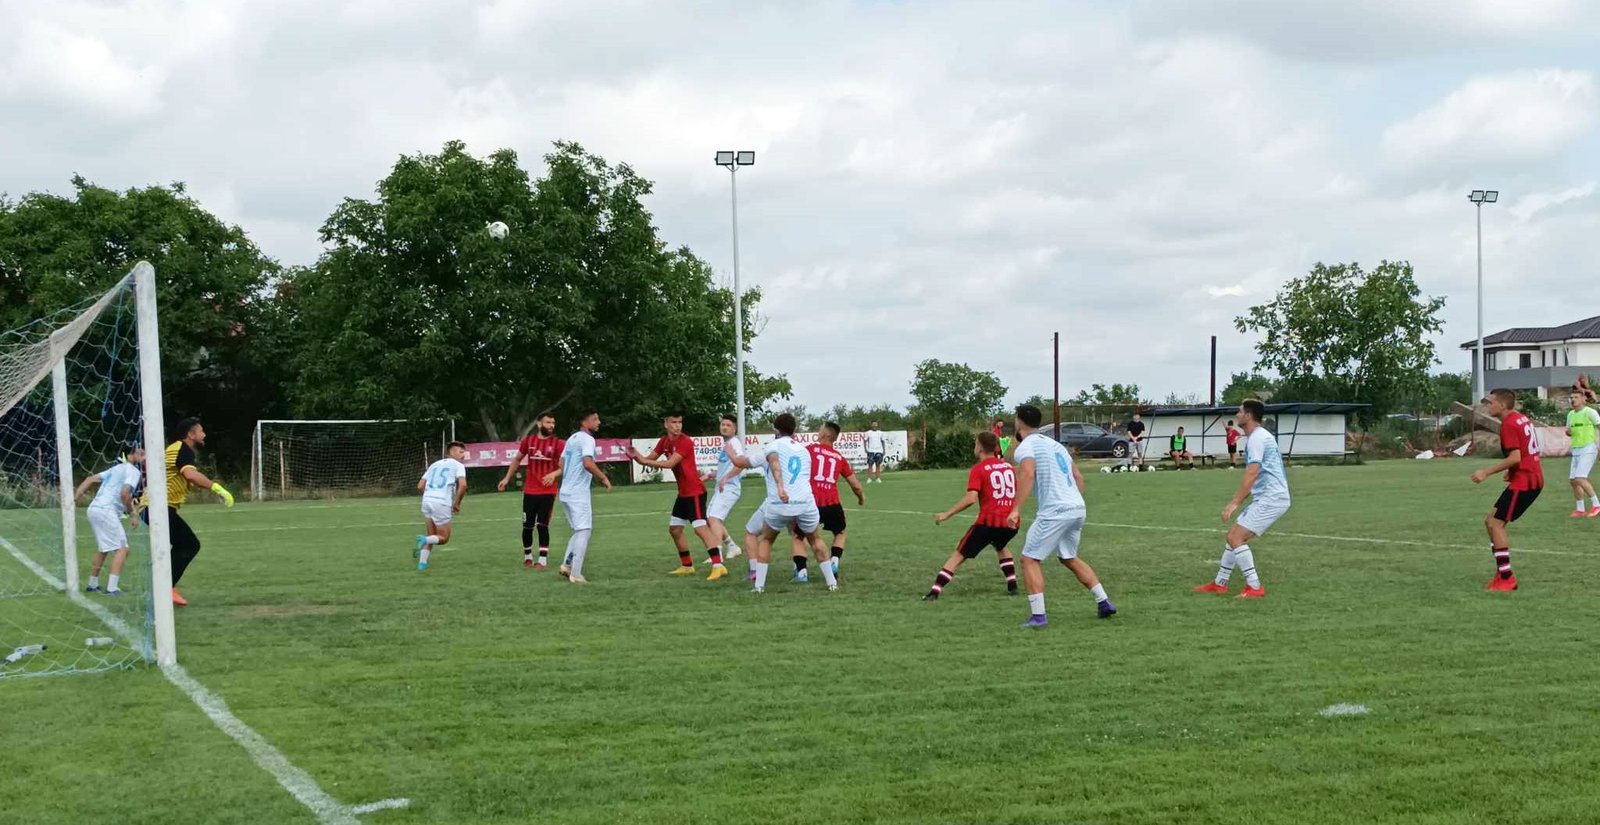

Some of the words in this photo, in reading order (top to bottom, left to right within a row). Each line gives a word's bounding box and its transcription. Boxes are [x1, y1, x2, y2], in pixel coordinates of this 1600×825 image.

[693, 437, 722, 447] CLUB
[744, 436, 760, 445] NA
[794, 434, 809, 443] AXI
[840, 433, 867, 442] AREN
[883, 451, 901, 464] osi
[428, 467, 450, 488] 15
[787, 454, 802, 485] 9
[813, 454, 837, 484] 11
[990, 469, 1016, 500] 99
